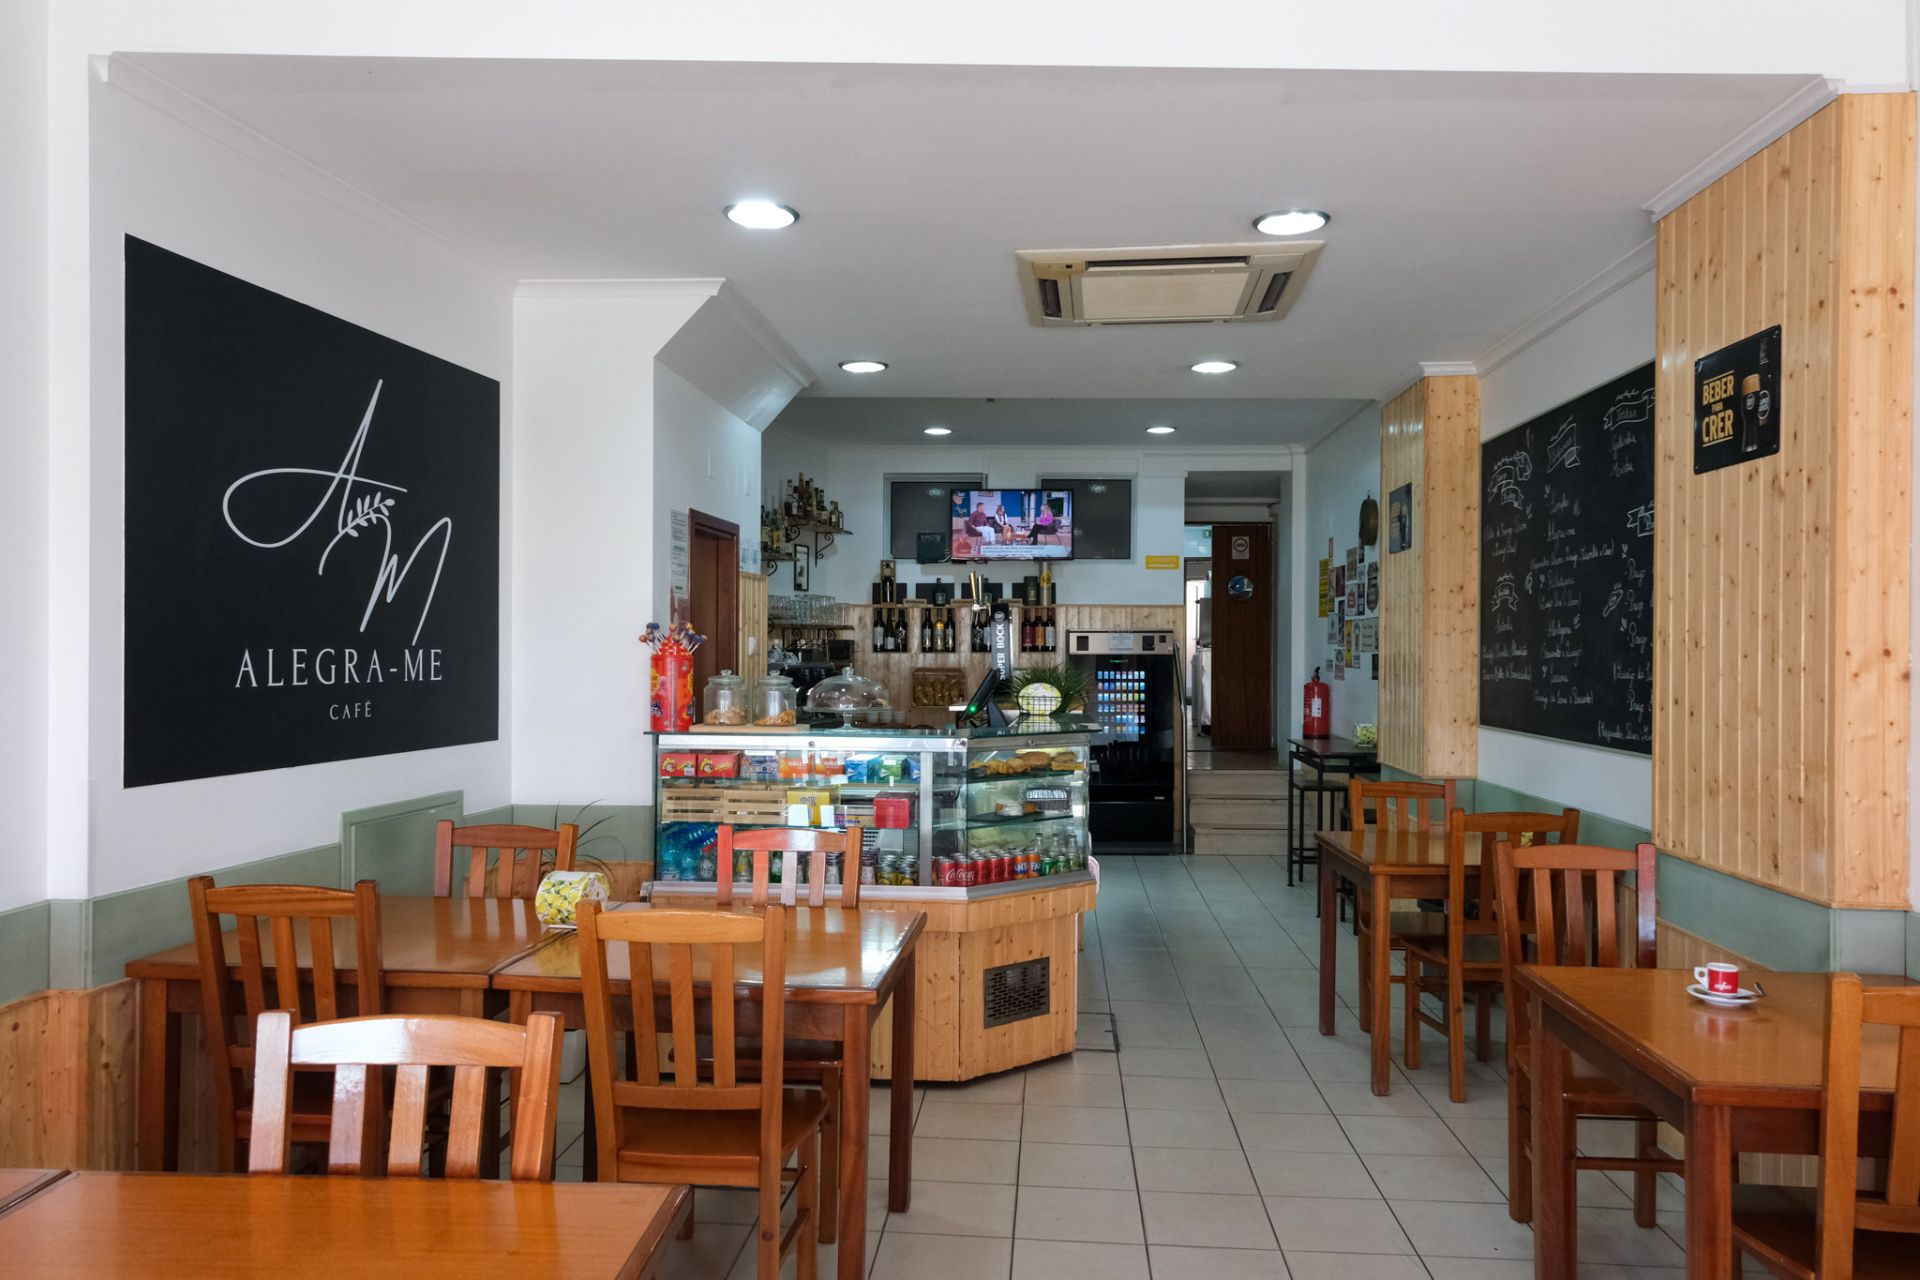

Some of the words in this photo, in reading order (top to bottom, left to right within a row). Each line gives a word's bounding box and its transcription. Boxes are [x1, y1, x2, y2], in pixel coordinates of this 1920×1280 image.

[1702, 375, 1734, 406] BEBER
[1702, 409, 1734, 443] CRER
[995, 623, 1005, 649] BOCK
[235, 648, 443, 688] ALEGRA-ME
[329, 700, 372, 720] CAFÉ
